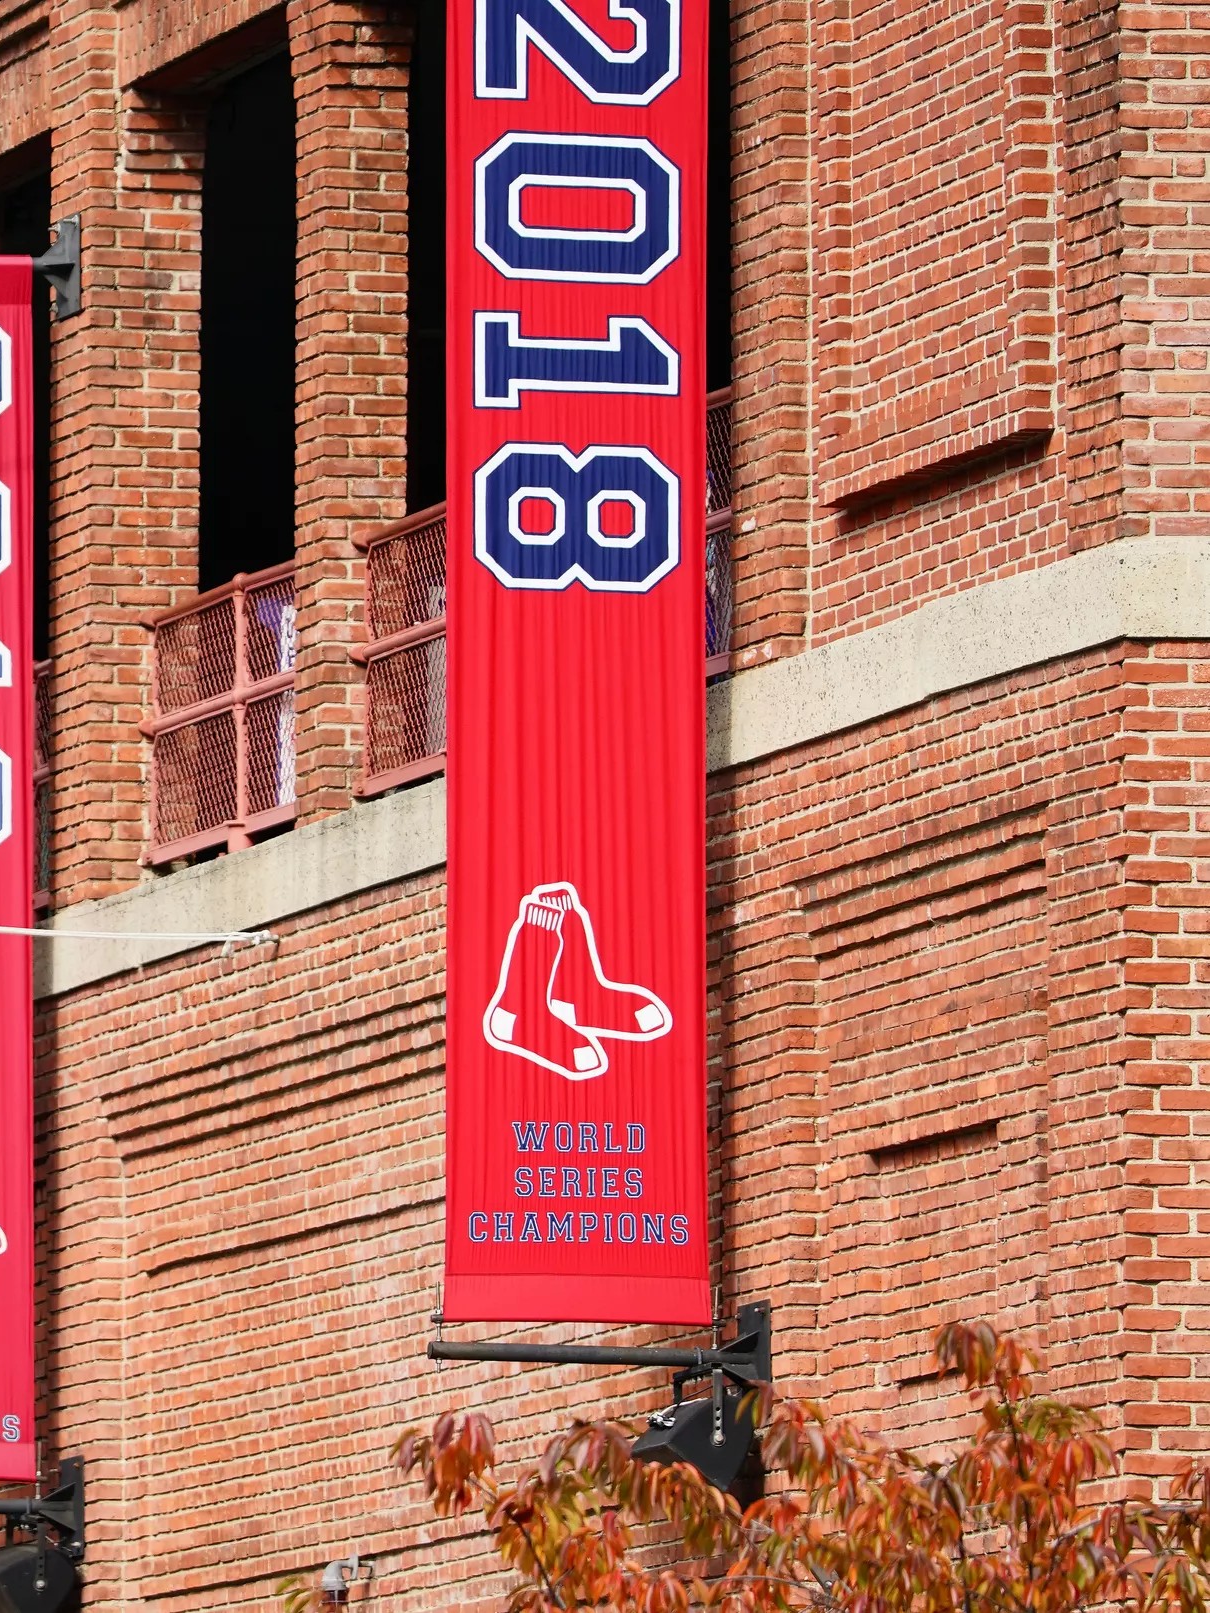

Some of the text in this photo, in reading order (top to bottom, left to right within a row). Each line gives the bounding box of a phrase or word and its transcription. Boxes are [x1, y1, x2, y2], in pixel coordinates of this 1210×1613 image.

[473, 0, 681, 593] 2018
[512, 1122, 646, 1153] WORLD
[515, 1167, 643, 1199] SERIES
[468, 1211, 690, 1245] CHAMPIONS
